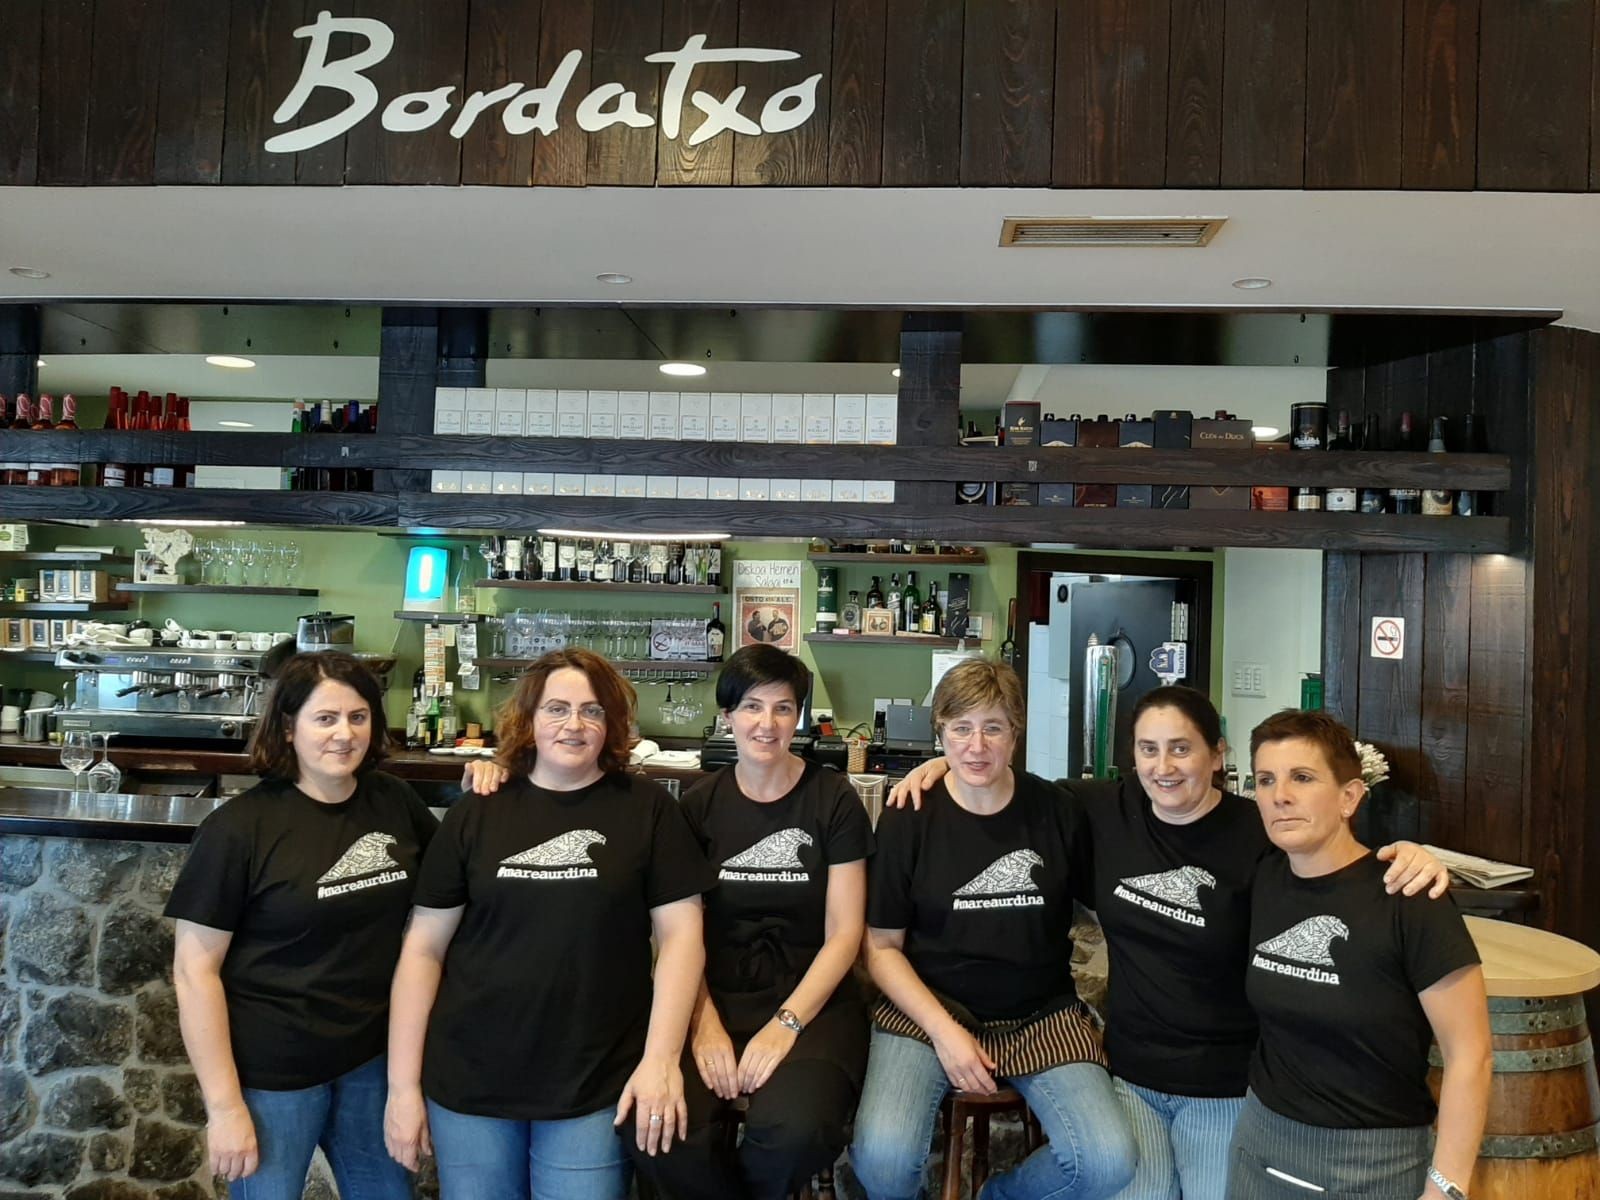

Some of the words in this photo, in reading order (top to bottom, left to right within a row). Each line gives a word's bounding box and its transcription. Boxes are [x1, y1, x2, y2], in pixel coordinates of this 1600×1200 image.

[496, 866, 598, 880] #mareaurdina
[718, 869, 810, 882] #mareaurdina
[317, 870, 408, 899] #mareaurdina
[952, 894, 1045, 910] #mareaurdina
[1113, 884, 1206, 927] #mareaurdina
